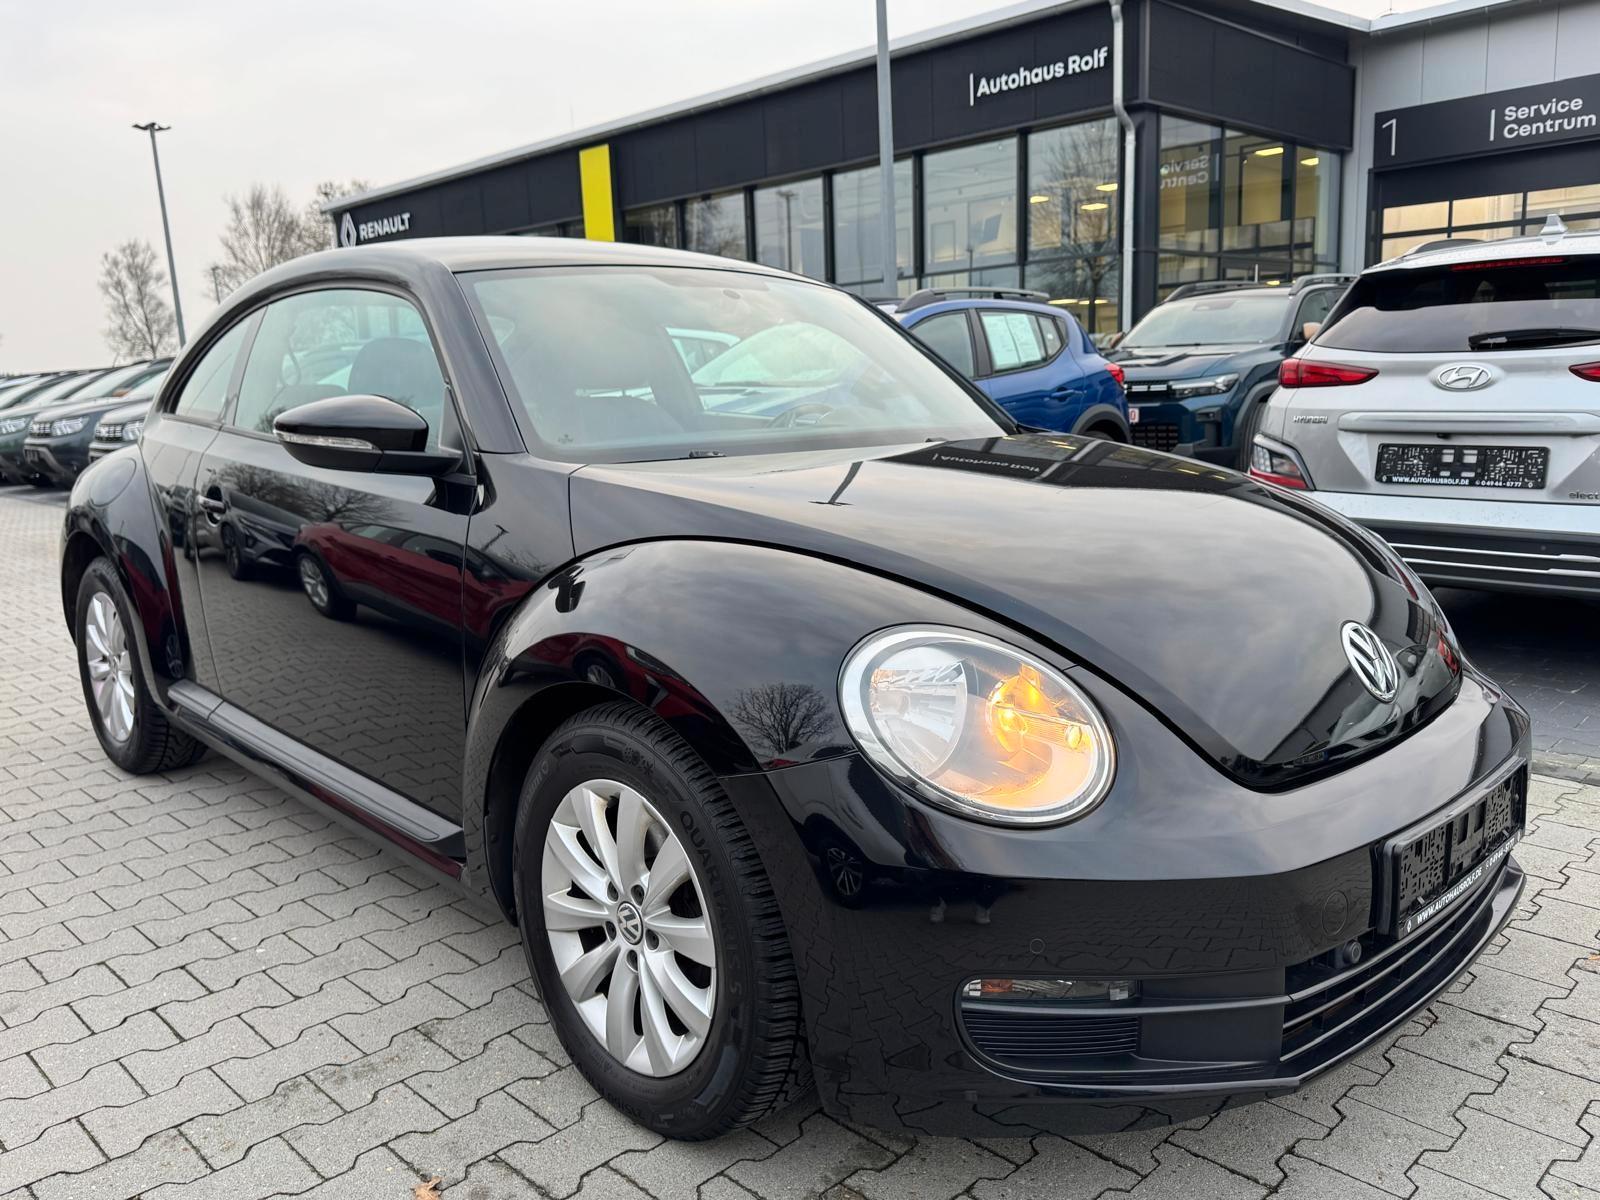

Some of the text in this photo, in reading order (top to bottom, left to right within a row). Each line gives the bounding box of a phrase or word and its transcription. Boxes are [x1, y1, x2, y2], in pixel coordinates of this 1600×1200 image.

[977, 46, 1109, 97] Autohaus Rolf
[1504, 97, 1584, 121] Service
[1382, 118, 1397, 156] 1
[1503, 114, 1597, 139] Centrum
[359, 212, 411, 241] RENAULT
[1293, 415, 1328, 424] HYUNDAI
[1391, 475, 1470, 486] WWW.AUTOHAUSROLF.DE
[1416, 866, 1483, 925] WWW.AUTOHAUSROLF.DE
